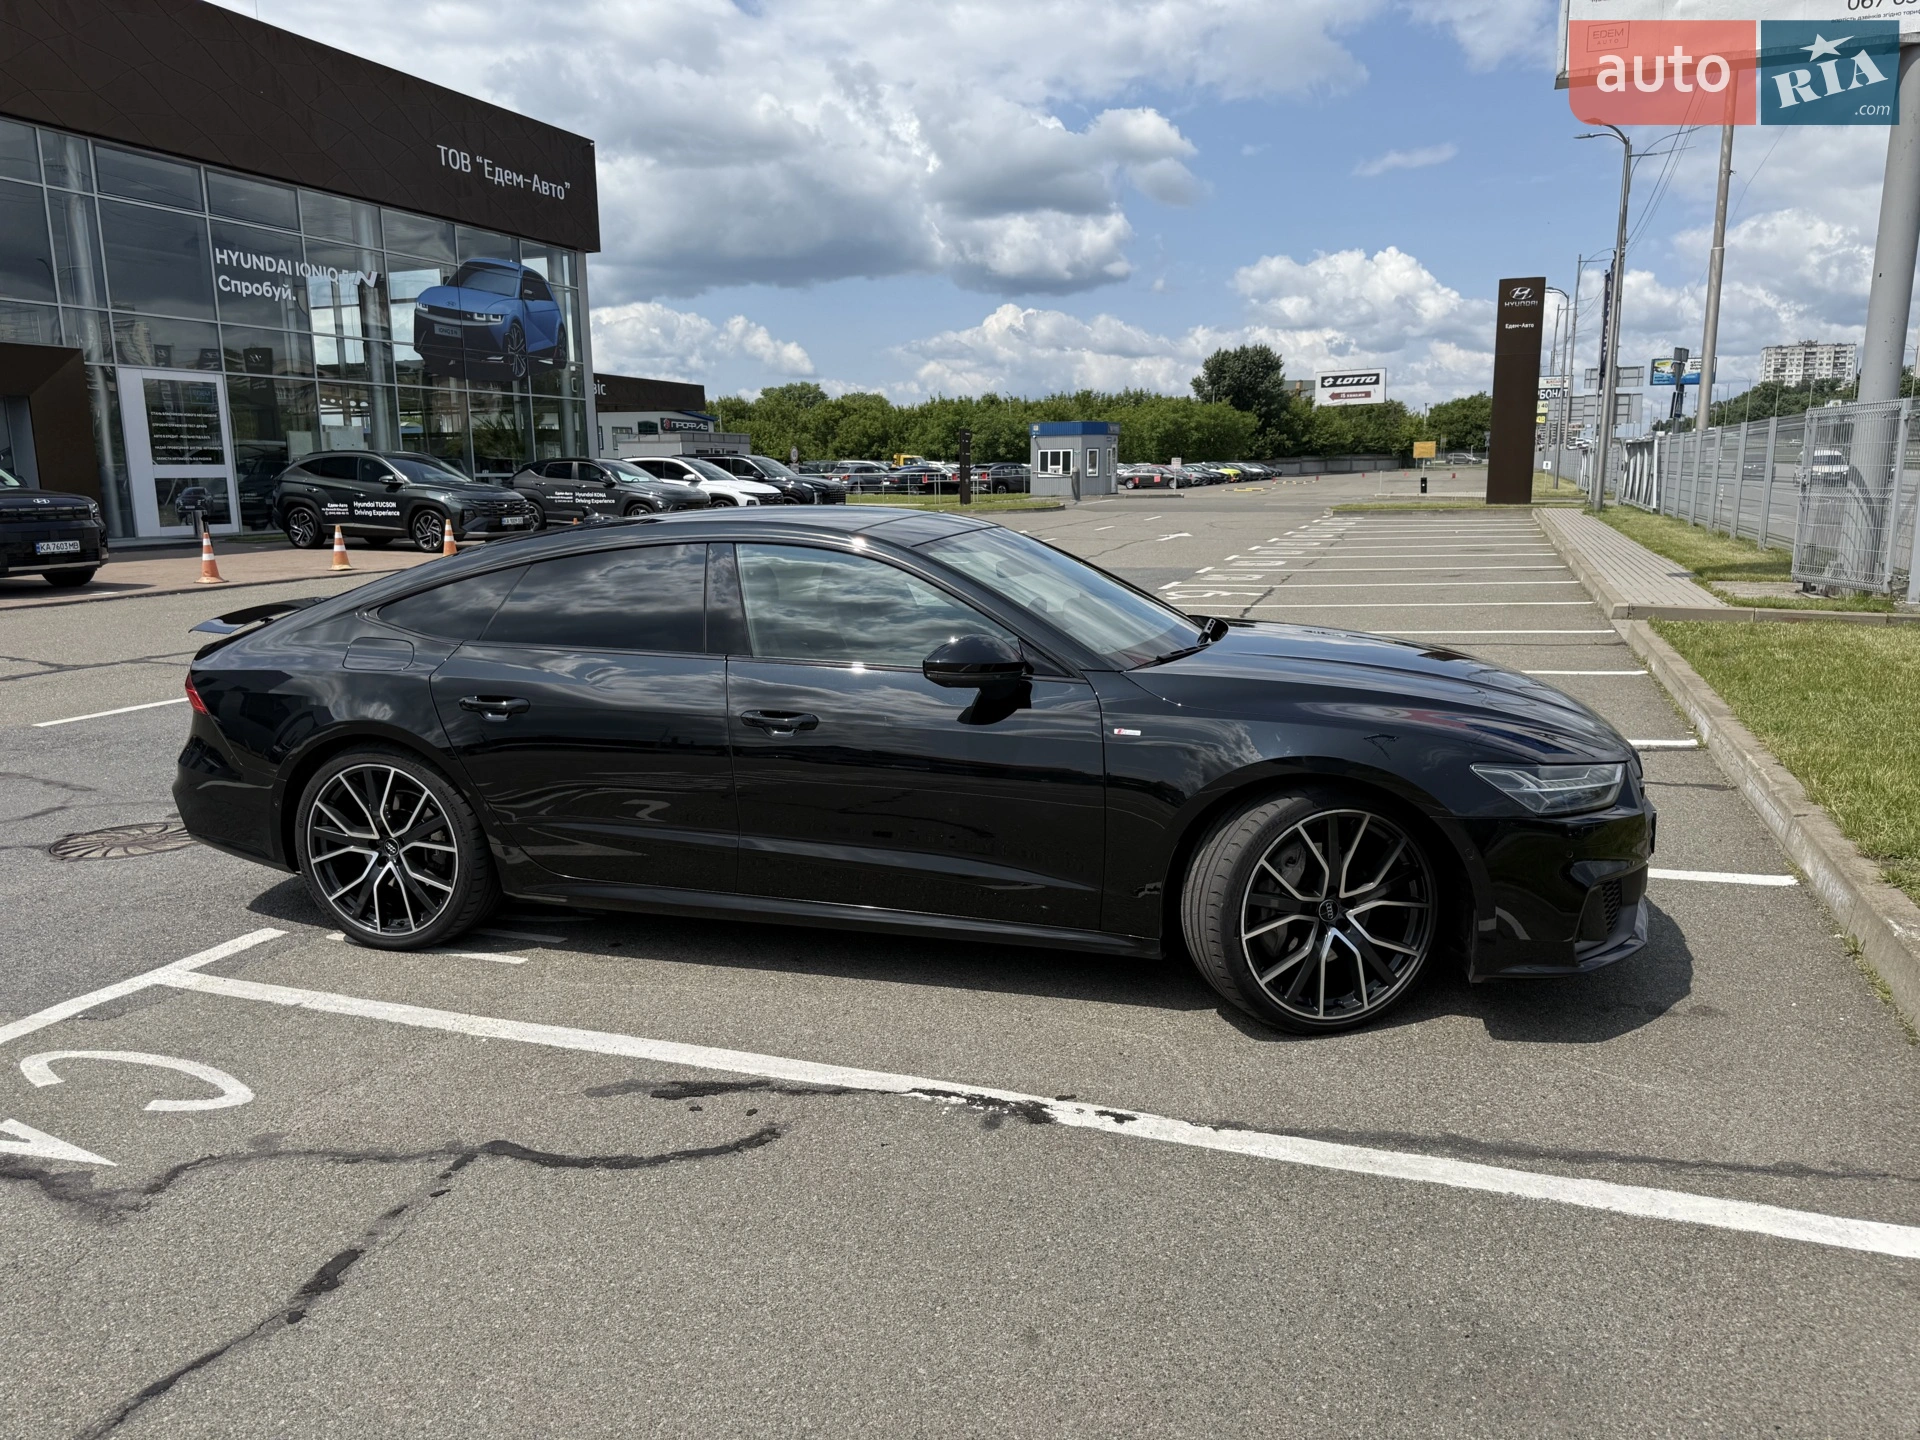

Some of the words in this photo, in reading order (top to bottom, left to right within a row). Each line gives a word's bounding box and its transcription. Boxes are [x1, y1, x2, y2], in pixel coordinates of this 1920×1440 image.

[1593, 28, 1624, 39] EDEM
[436, 144, 472, 173] ТОВ
[215, 248, 292, 276] HYUNDAI
[296, 260, 339, 285] IONIQ
[218, 275, 296, 301] Спробуй.
[1336, 375, 1378, 385] LOTTO
